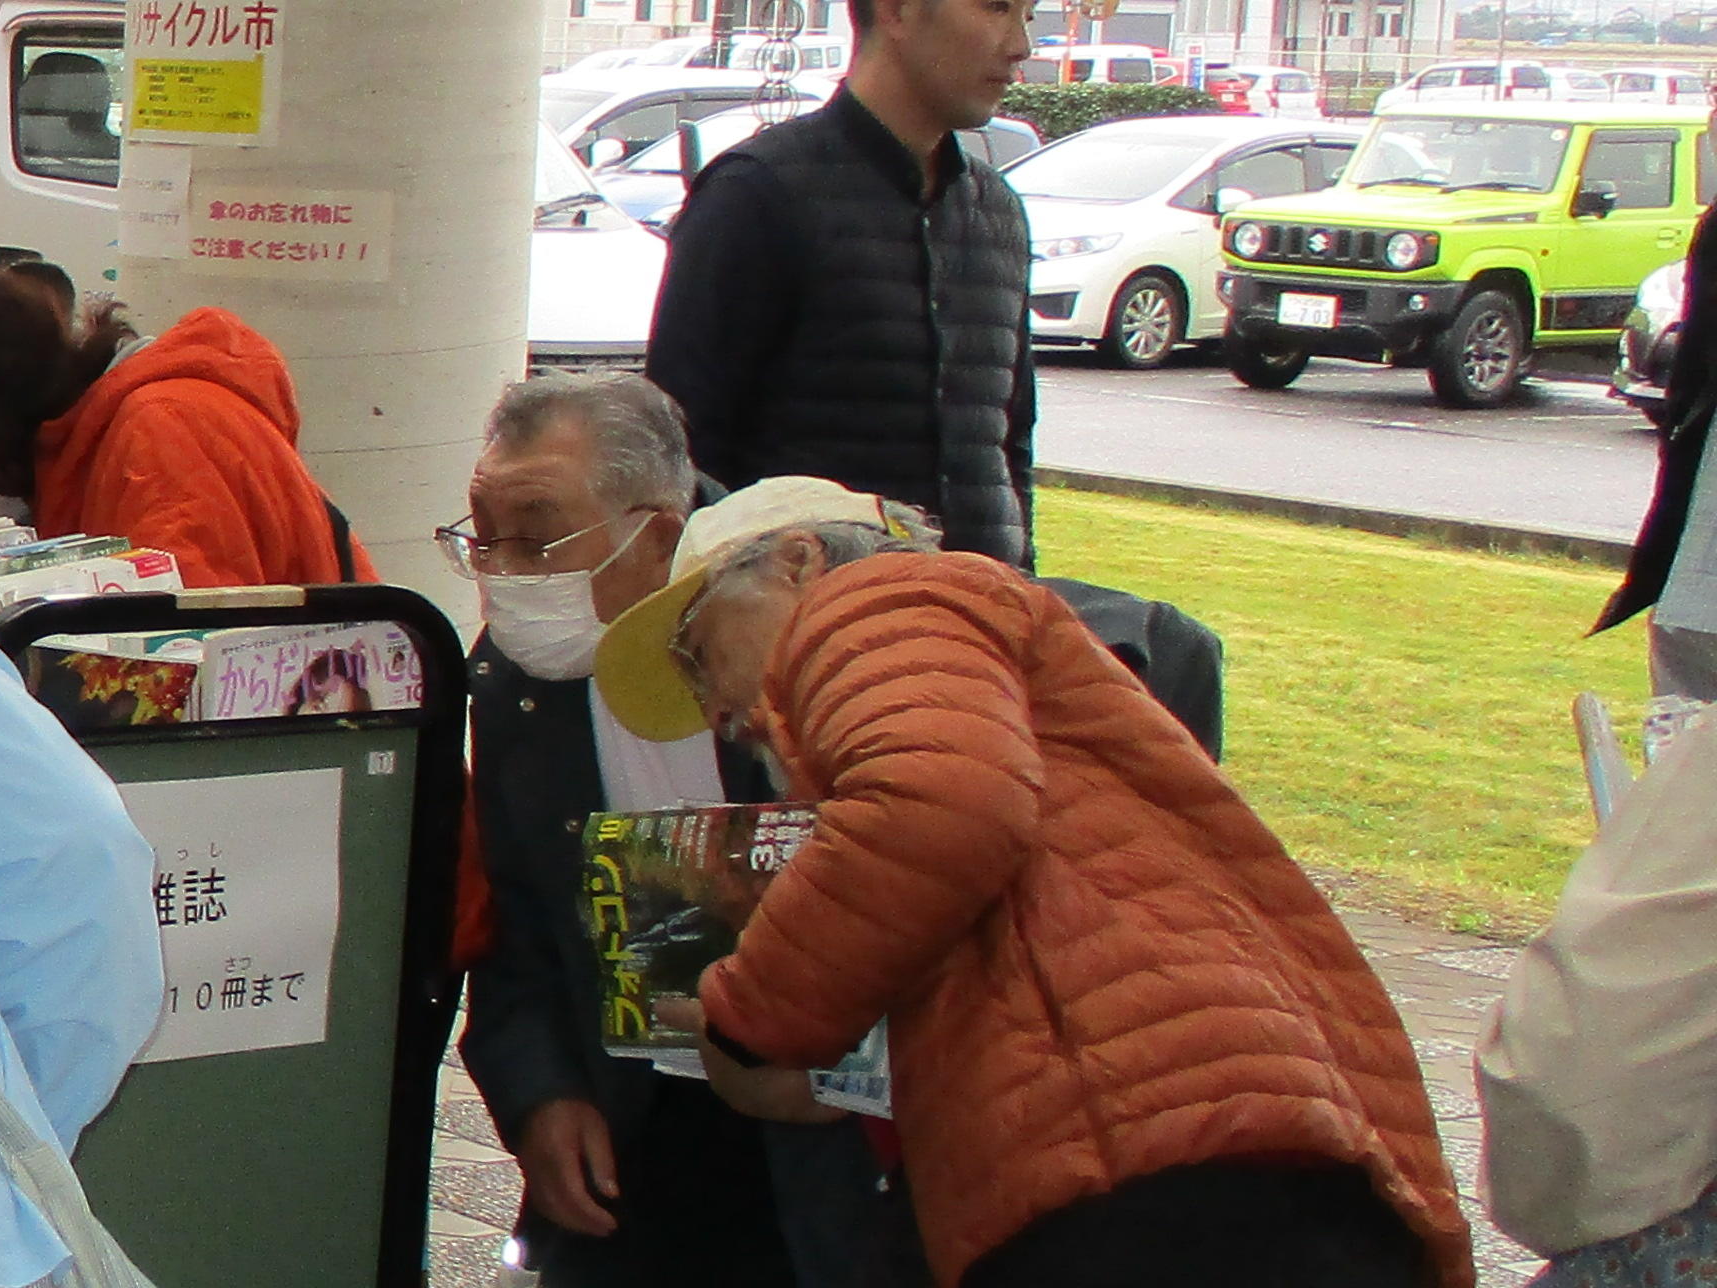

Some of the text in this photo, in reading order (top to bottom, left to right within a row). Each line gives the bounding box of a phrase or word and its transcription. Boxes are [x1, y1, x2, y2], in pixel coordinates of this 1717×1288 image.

[208, 200, 353, 225] 傘のお忘れ物に
